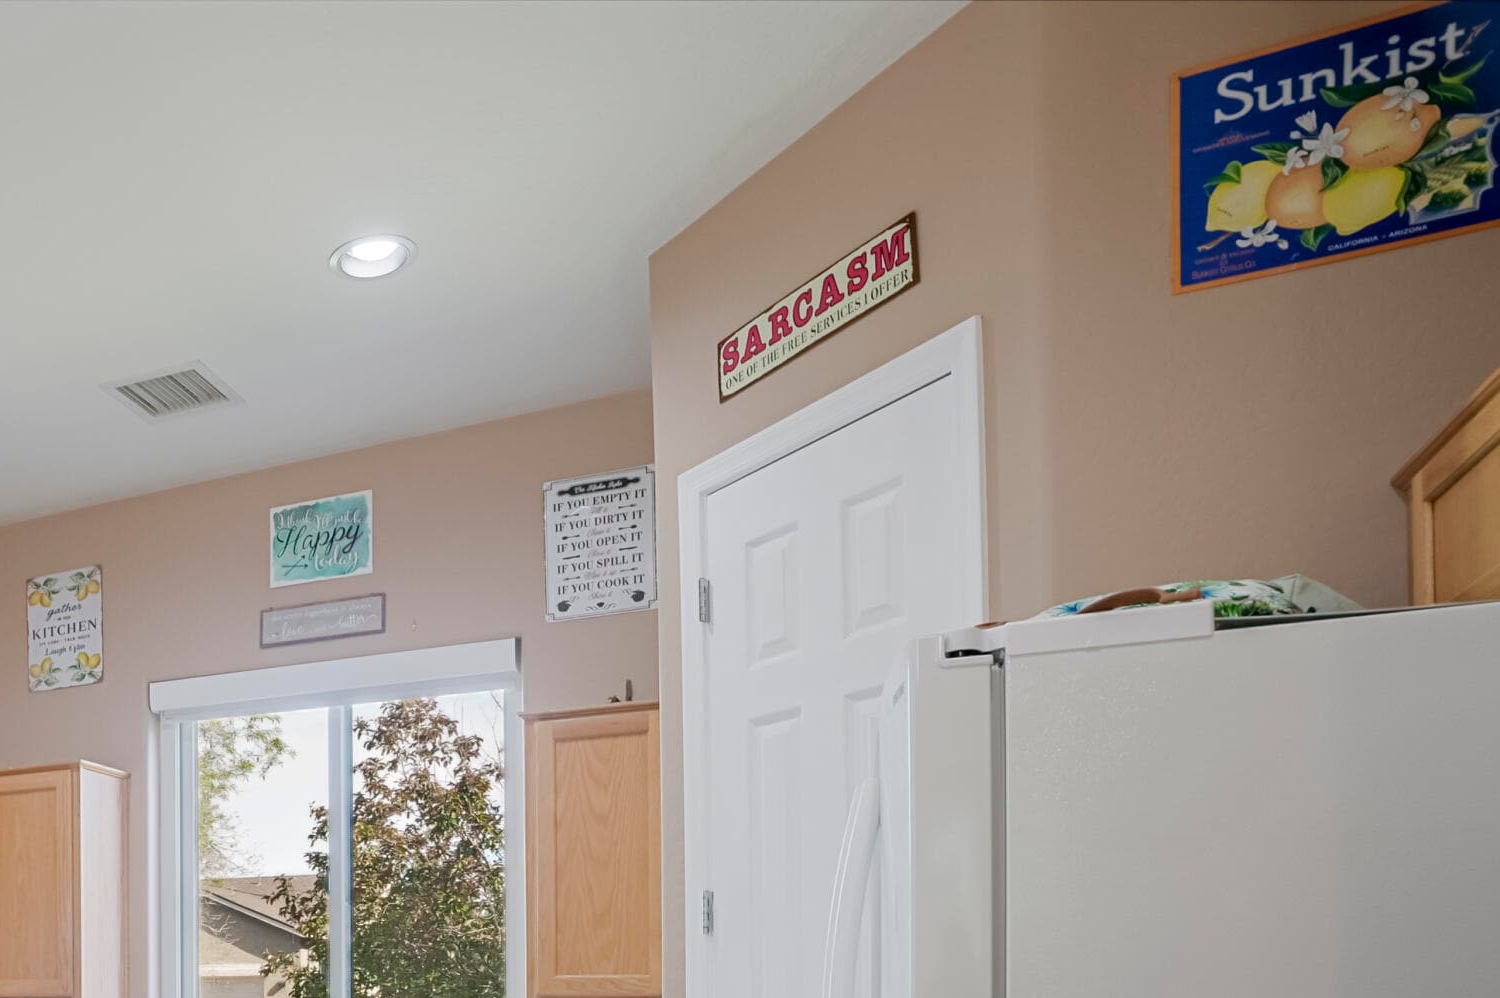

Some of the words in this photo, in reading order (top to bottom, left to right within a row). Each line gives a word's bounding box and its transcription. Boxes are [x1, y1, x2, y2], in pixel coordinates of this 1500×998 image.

[1214, 21, 1467, 125] Sunkist
[1327, 234, 1379, 252] CALIFORNIA
[1388, 224, 1429, 239] ARIZONA
[722, 225, 910, 375] SARCASM
[725, 371, 745, 390] ONE
[746, 361, 760, 376] OF
[761, 348, 781, 369] THE
[782, 331, 808, 358] FREE
[810, 299, 862, 339] SERVICES
[870, 268, 909, 301] OFFER
[553, 503, 565, 512] IF
[567, 497, 589, 511] YOU
[592, 490, 632, 506] EMPTY
[634, 488, 647, 499] IT
[555, 522, 566, 533] IF
[569, 518, 591, 530] YOU
[594, 512, 629, 527] DIRTY
[632, 509, 645, 519] IT
[276, 522, 364, 561] Happy
[557, 543, 568, 554] IF
[570, 539, 593, 551] YOU
[596, 533, 627, 547] OPEN
[630, 531, 643, 542] IT
[314, 545, 359, 572] today
[557, 564, 568, 575] IF
[571, 560, 593, 573] YOU
[596, 555, 629, 569] SPILL
[631, 552, 644, 563] IT
[557, 585, 569, 596] IF
[571, 581, 594, 594] YOU
[597, 576, 630, 589] COOK
[633, 574, 646, 584] IT
[32, 618, 98, 641] KITCHEN
